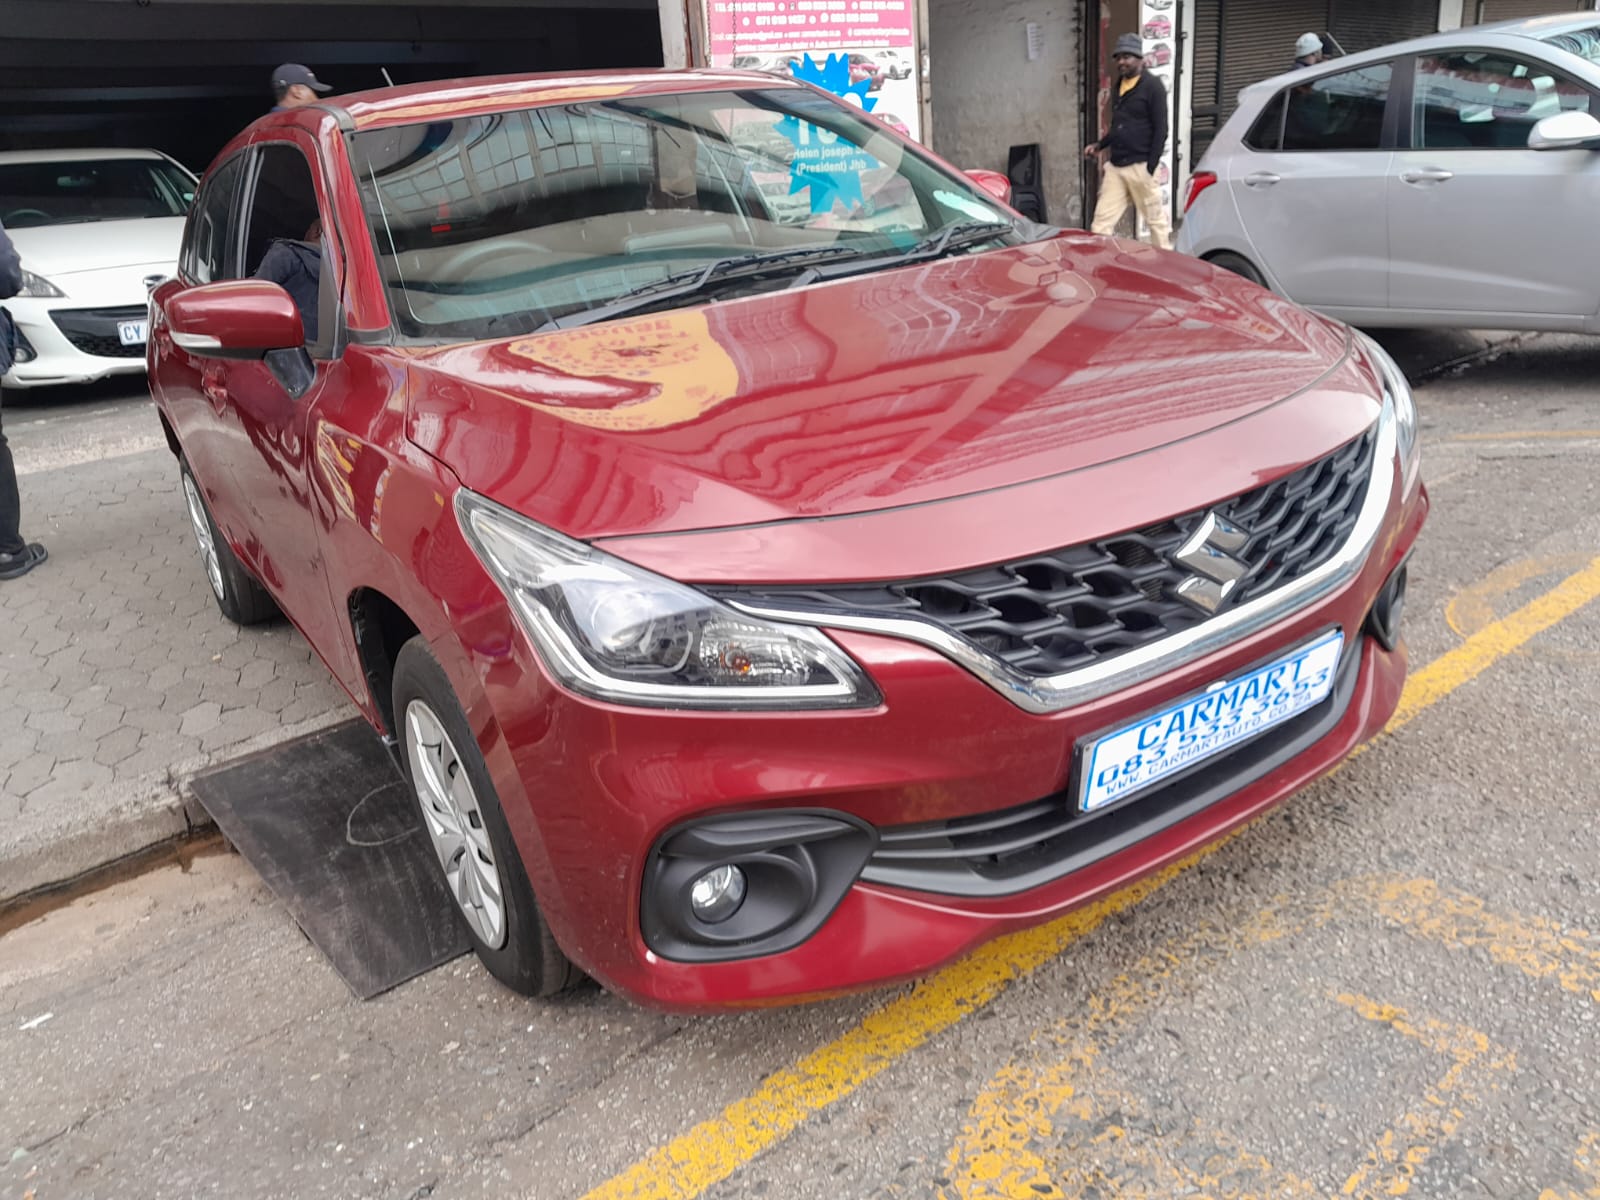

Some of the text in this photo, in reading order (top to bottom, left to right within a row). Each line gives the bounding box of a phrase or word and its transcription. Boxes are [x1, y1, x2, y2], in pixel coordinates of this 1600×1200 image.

[796, 157, 867, 177] (President) Jhb
[1097, 667, 1329, 787] 083 533 3653
[1137, 655, 1310, 750] CARMART
